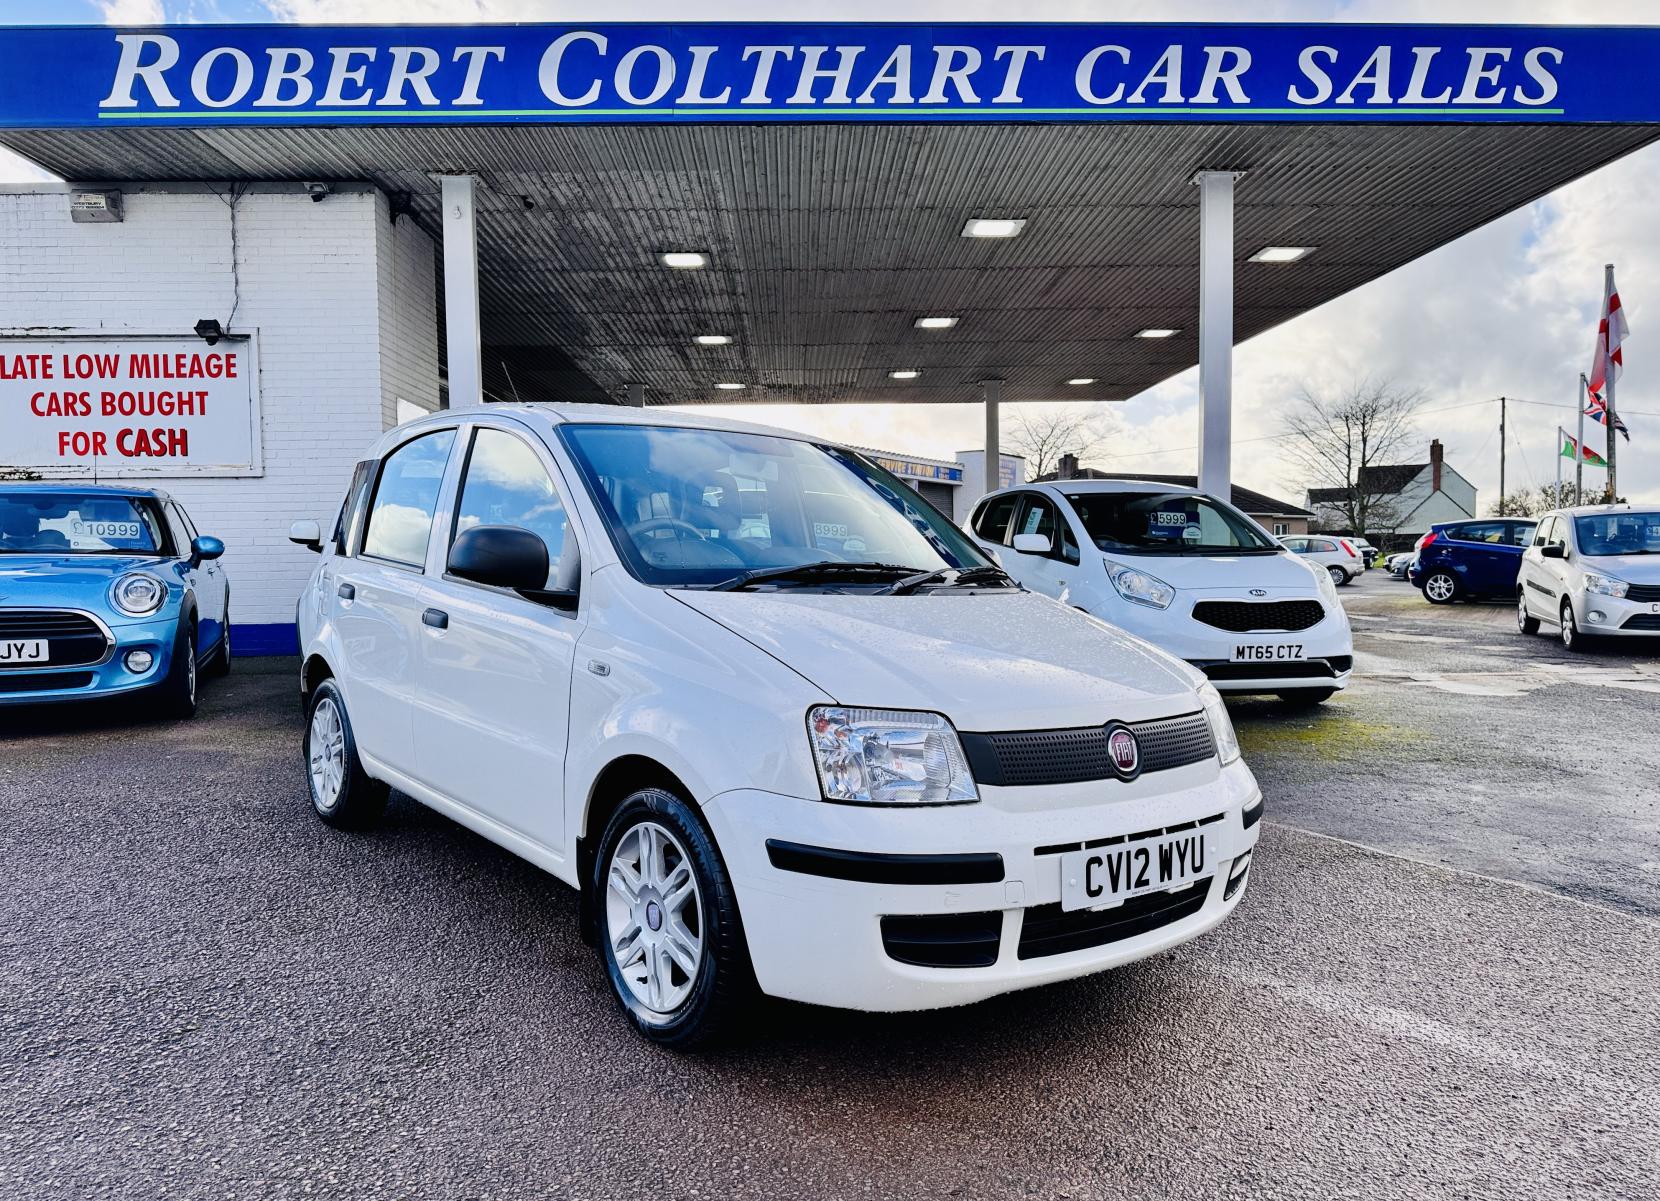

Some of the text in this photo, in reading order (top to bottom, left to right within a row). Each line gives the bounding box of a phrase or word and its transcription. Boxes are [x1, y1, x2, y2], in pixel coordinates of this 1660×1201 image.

[98, 31, 1564, 108] ROBERT COLTHART CAR SALES
[0, 353, 238, 380] LATE LOW MILEAGE
[30, 391, 208, 417] CARS BOUGHT
[58, 428, 189, 457] FOR CASH
[815, 524, 846, 536] 8999
[0, 643, 40, 659] JYJ
[1236, 645, 1303, 659] MT65 CTZ
[1115, 742, 1133, 761] FIAT
[1085, 834, 1205, 898] CV12 WYU
